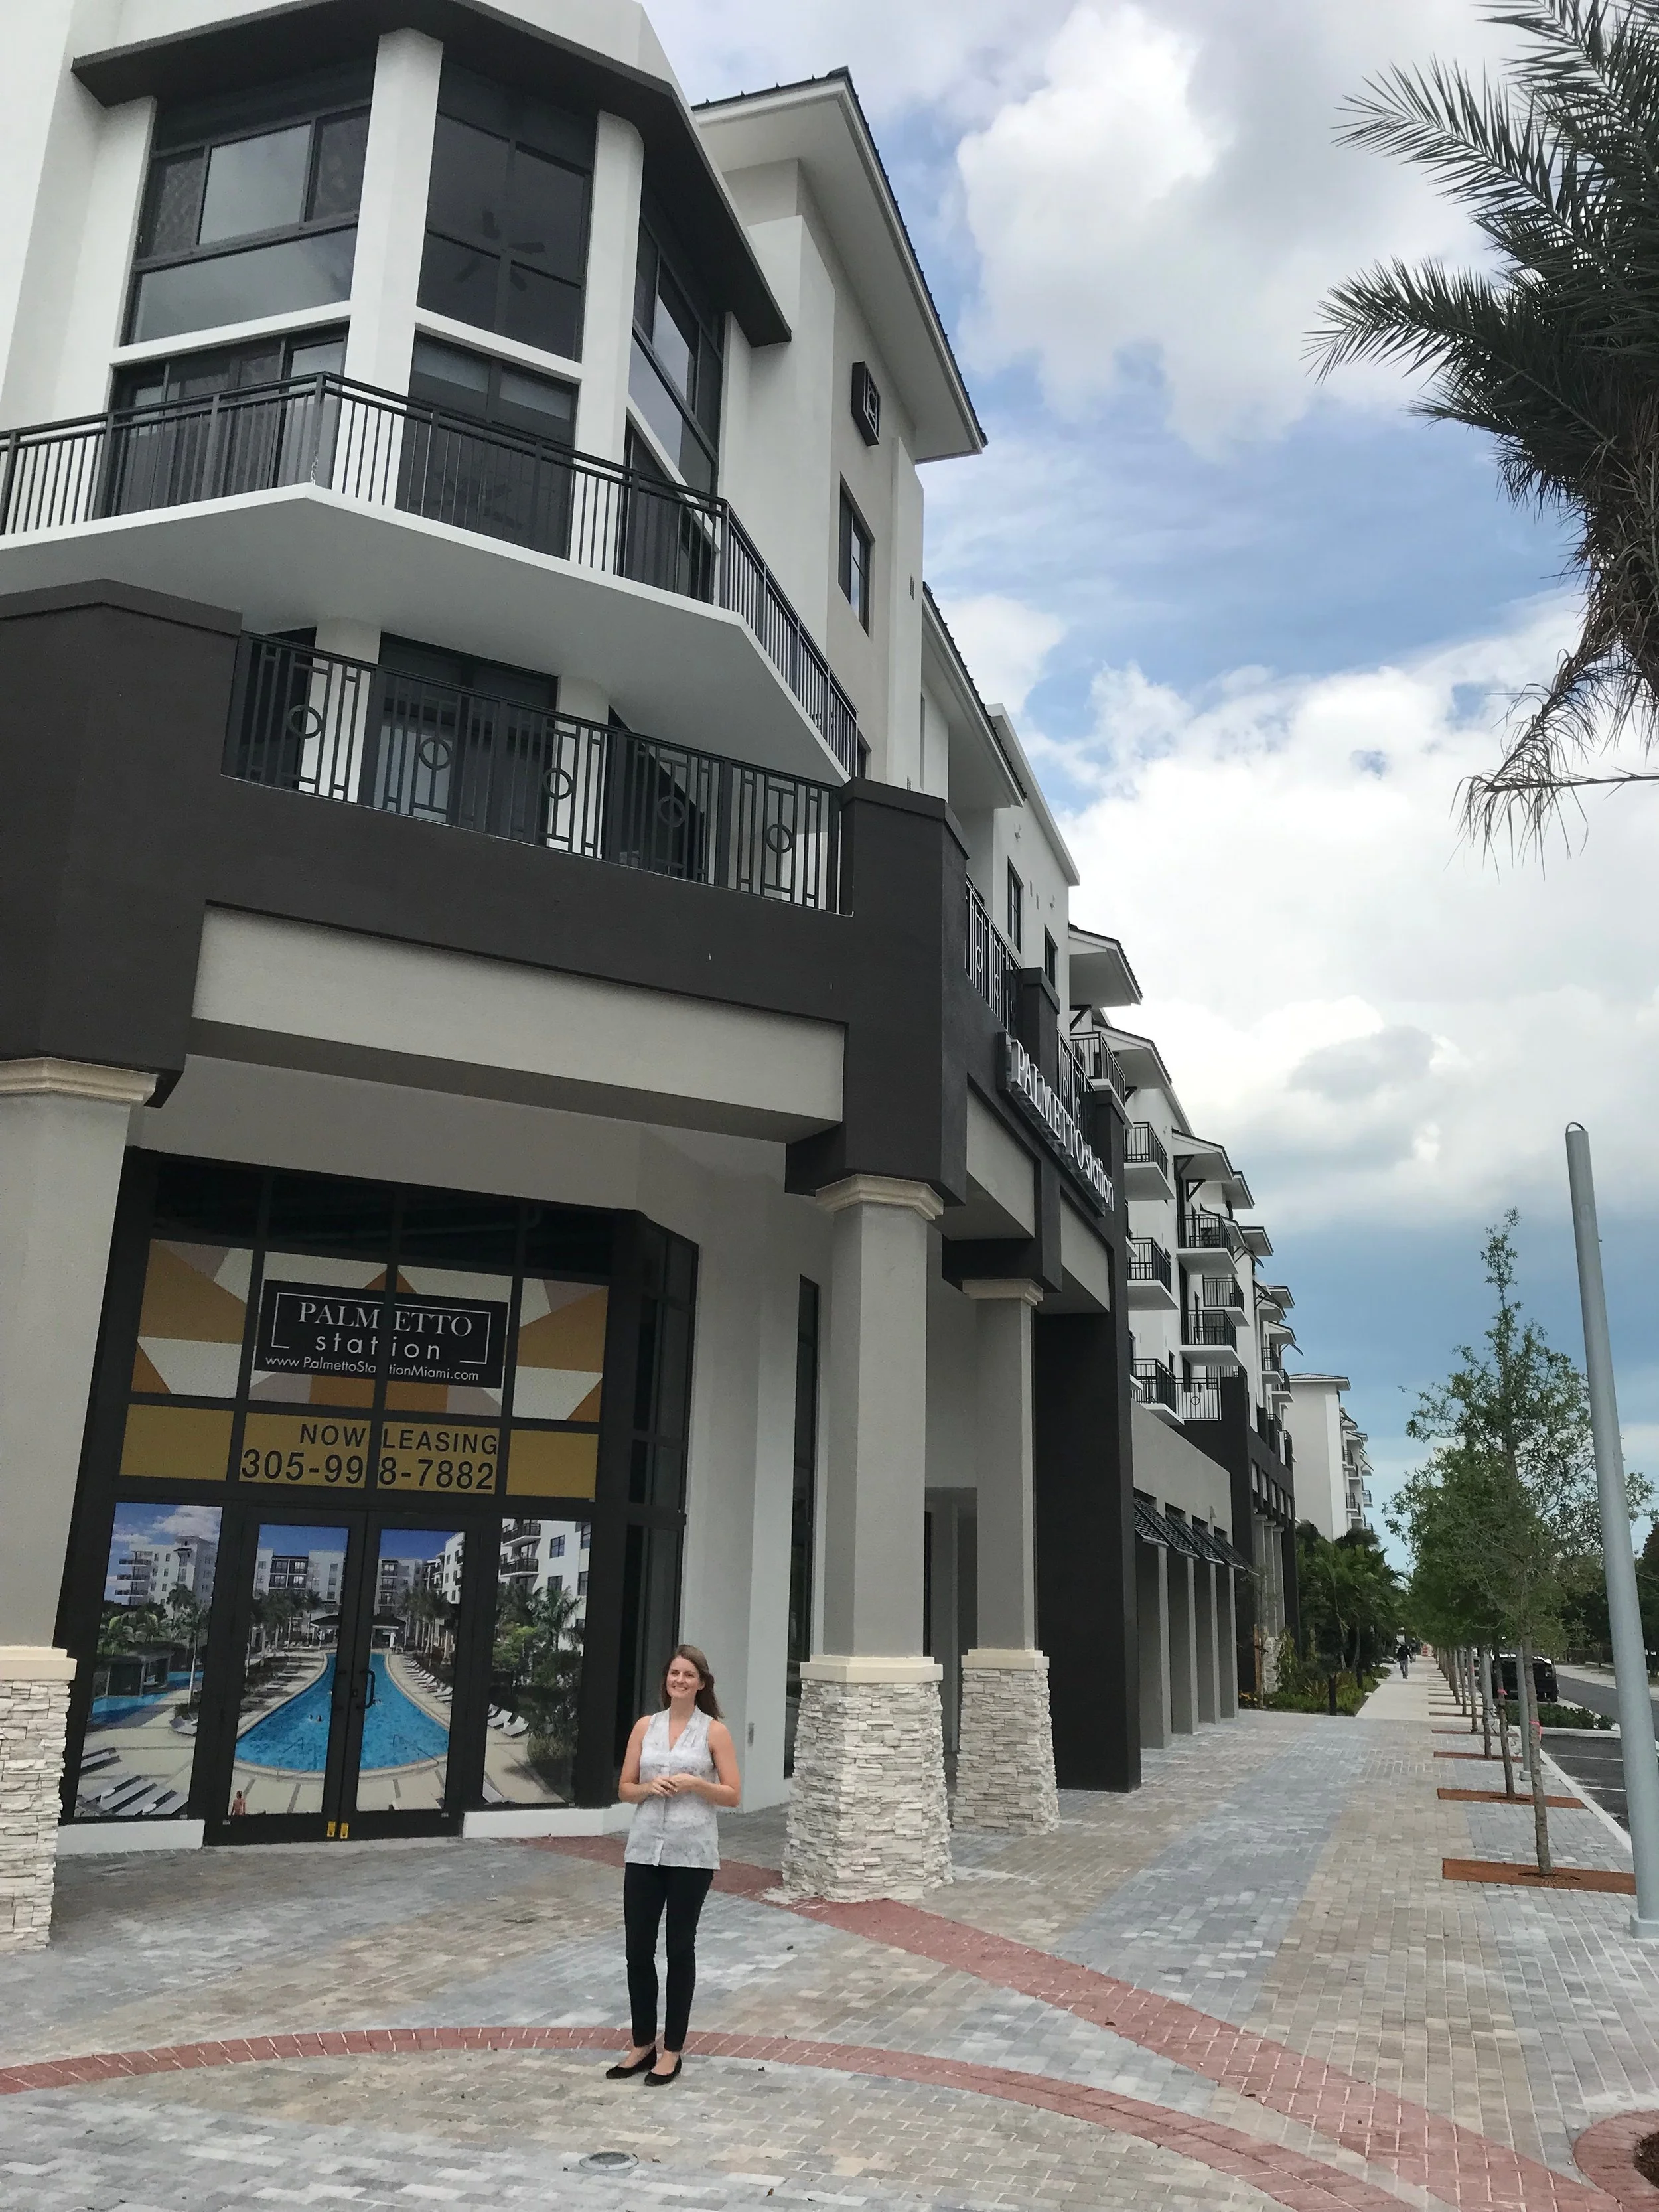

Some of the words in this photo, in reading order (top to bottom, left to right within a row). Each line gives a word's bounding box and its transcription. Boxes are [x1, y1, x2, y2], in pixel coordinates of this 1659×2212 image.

[1011, 1039, 1084, 1169] PALMETTO
[1085, 1145, 1114, 1212] station
[299, 1301, 472, 1337] PALMETTO
[315, 1333, 440, 1360] station
[299, 1424, 366, 1447] NOW
[382, 1428, 498, 1455] LEASING
[242, 1449, 494, 1491] 305-998-7882
